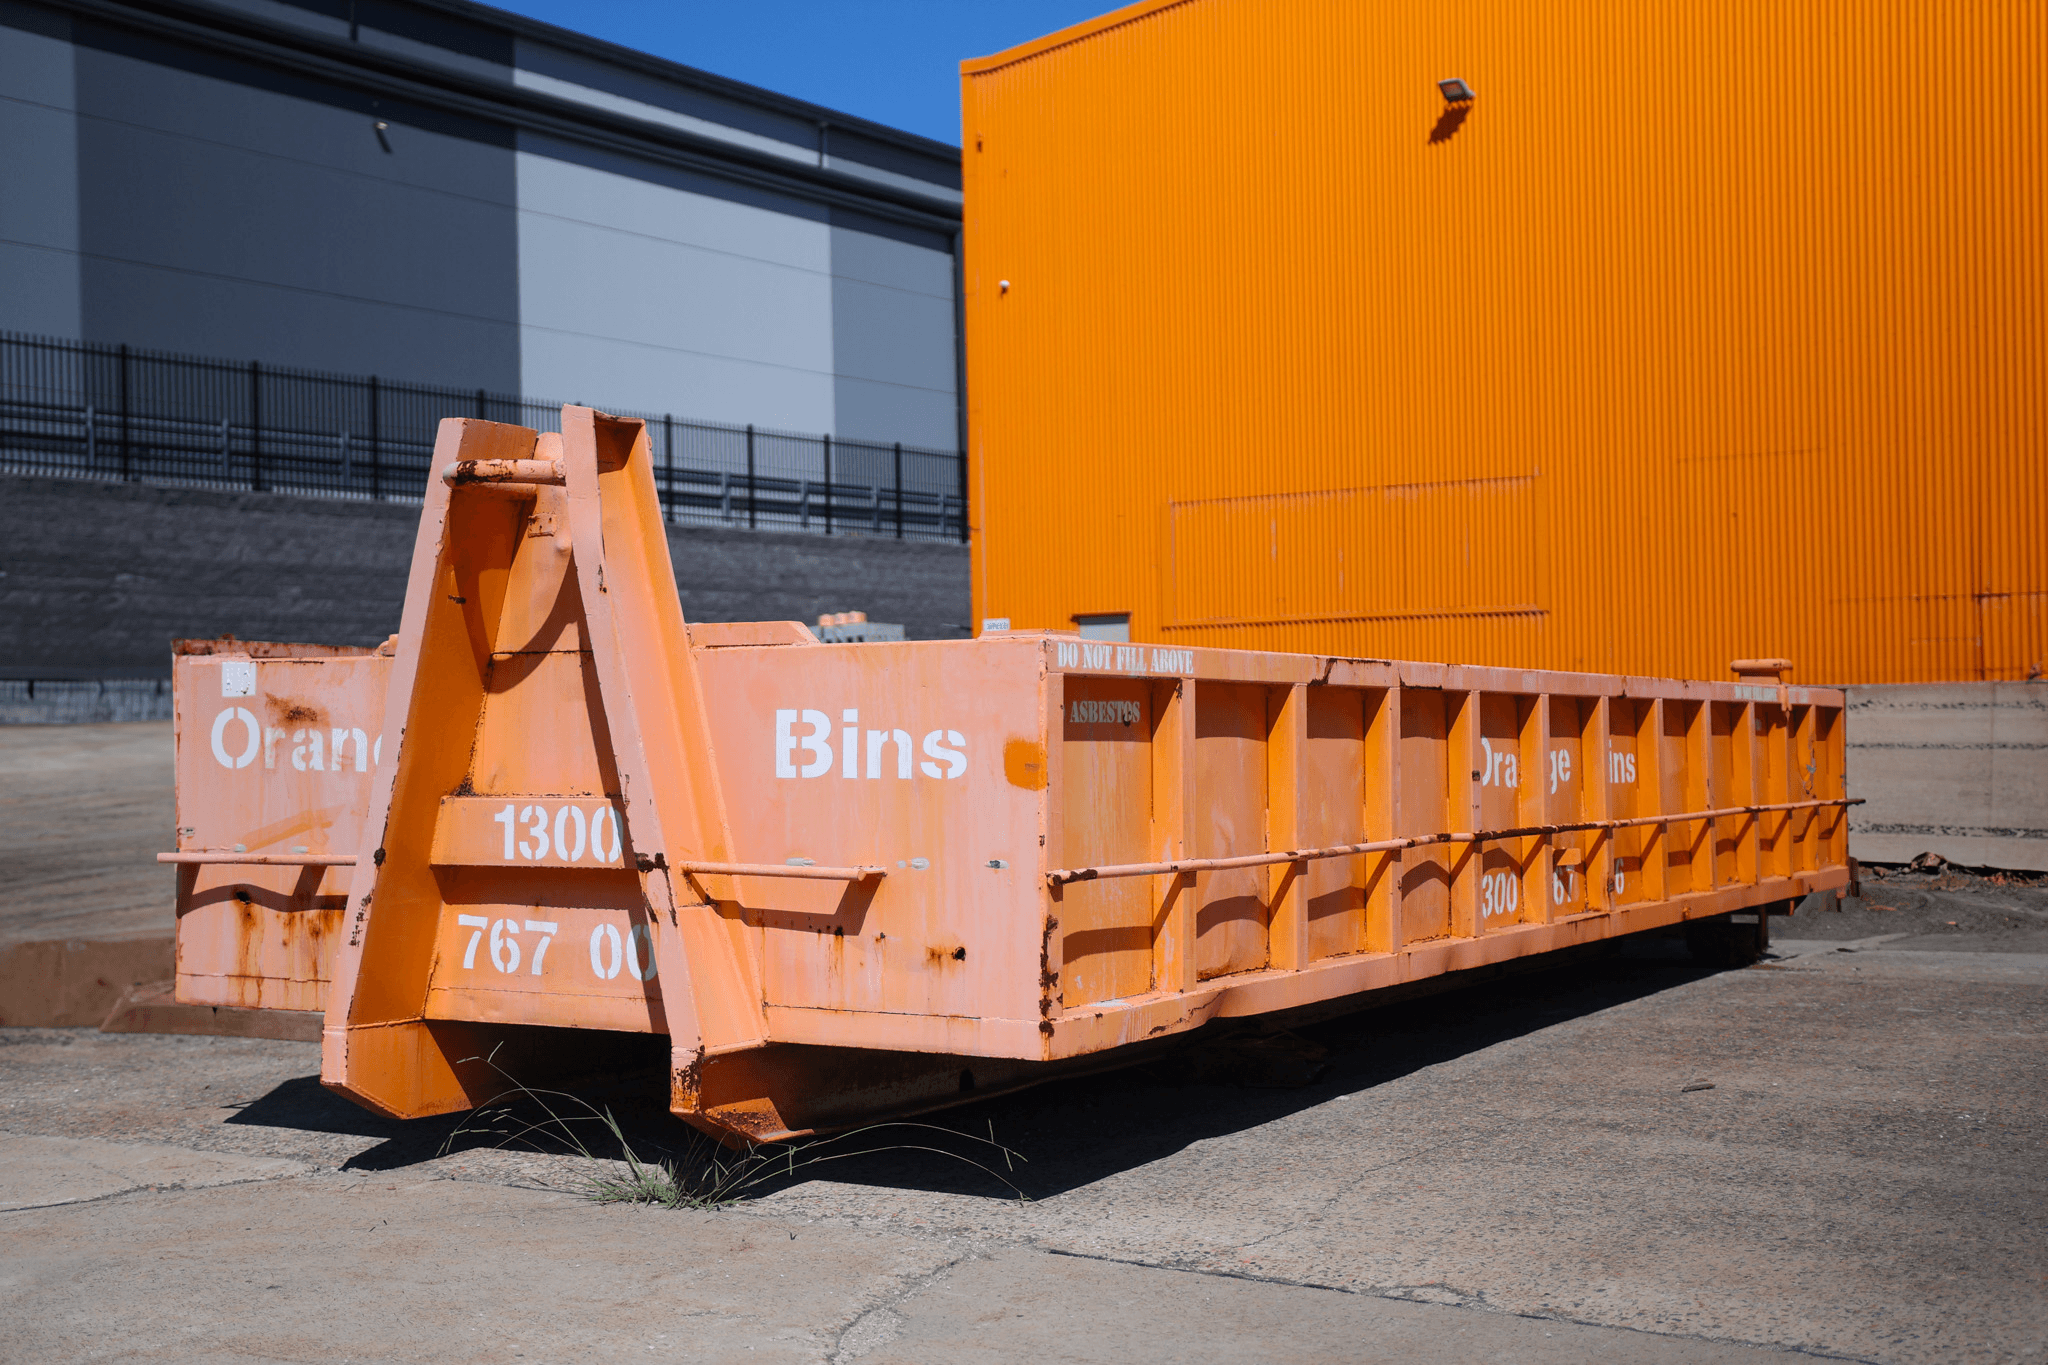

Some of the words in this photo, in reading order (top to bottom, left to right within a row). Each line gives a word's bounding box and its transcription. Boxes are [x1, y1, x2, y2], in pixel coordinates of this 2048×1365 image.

[1057, 642, 1079, 668] DO
[1082, 643, 1113, 670] NOT
[1116, 646, 1147, 672] FILL
[1150, 648, 1194, 674] ABOVE
[1070, 701, 1141, 723] ASBESTOS
[211, 706, 383, 772] Oran
[775, 708, 968, 780] Bins
[494, 804, 624, 863] 1300
[1482, 871, 1518, 918] 300
[458, 914, 559, 976] 767
